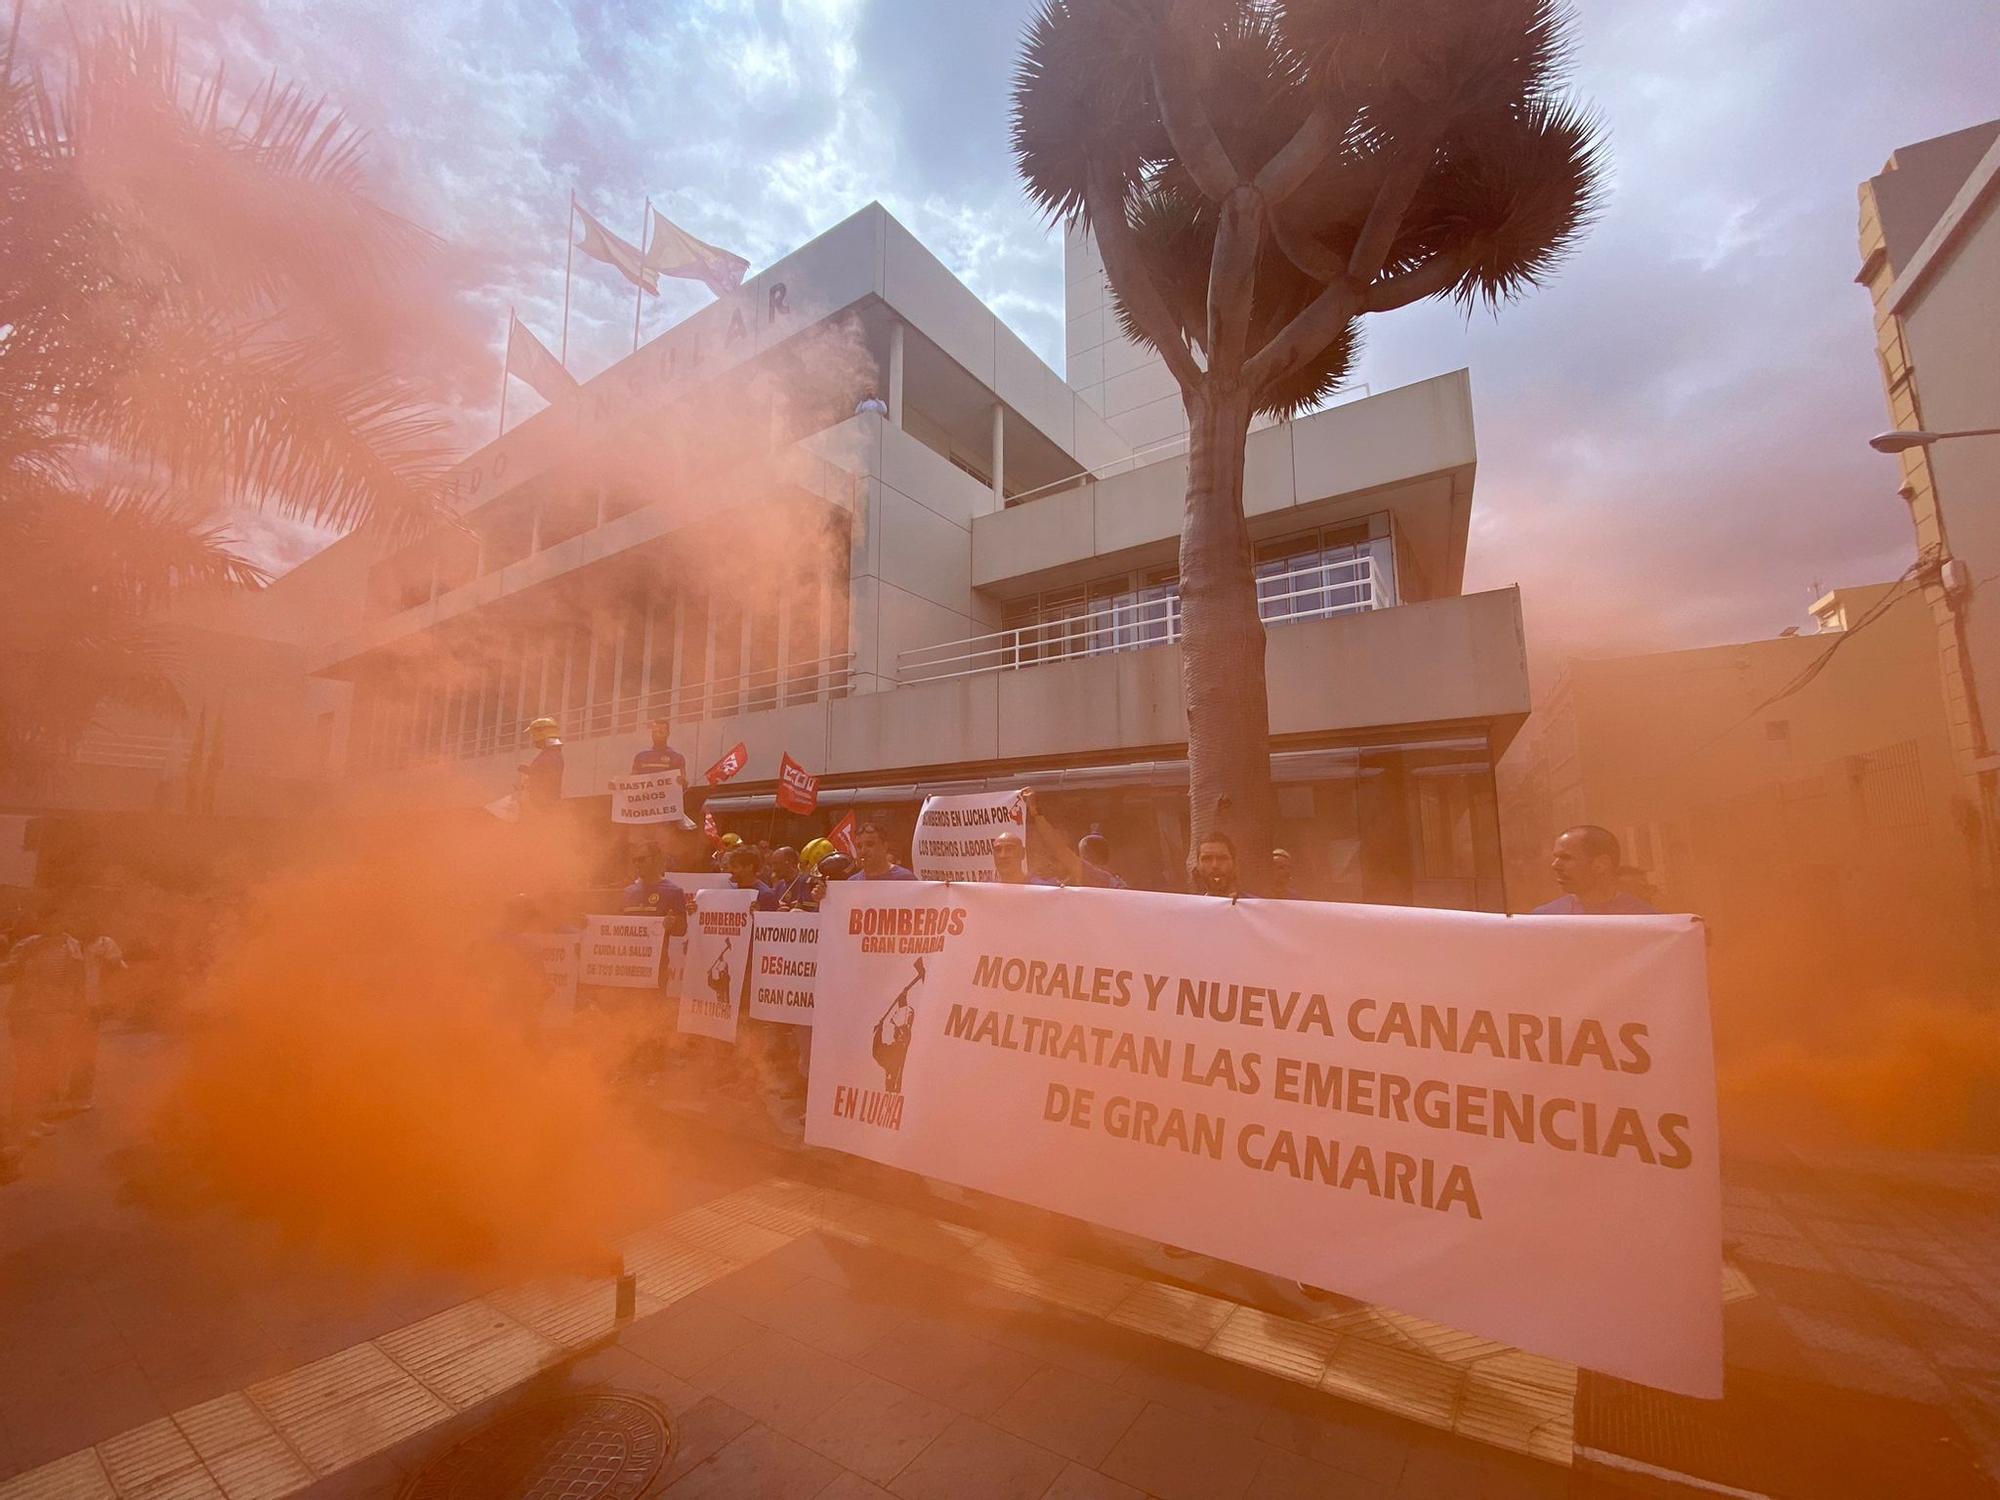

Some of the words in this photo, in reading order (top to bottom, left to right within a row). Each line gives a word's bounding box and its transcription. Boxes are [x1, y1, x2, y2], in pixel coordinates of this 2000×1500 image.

[619, 780, 655, 790] BASTA
[657, 778, 672, 787] DE
[627, 791, 666, 802] DAÑOS
[621, 805, 677, 818] MORALES
[951, 809, 961, 827] EN
[962, 808, 990, 826] LUCHA
[991, 807, 1011, 824] POR
[919, 839, 929, 855] LOS
[699, 914, 748, 927] BOMBEROS
[848, 907, 966, 936] BOMBEROS
[600, 924, 612, 938] SR.
[613, 925, 650, 939] MORALES,
[755, 927, 796, 945] ANTONIO
[593, 944, 616, 957] CUIDA
[617, 945, 627, 957] LA
[629, 945, 652, 958] SALUD
[861, 934, 896, 953] GRAN
[899, 935, 945, 953] CANARIA
[758, 987, 783, 1004] GRAN
[692, 999, 703, 1015] EN
[705, 1000, 731, 1019] LUCHA
[973, 954, 1131, 1007] MORALES
[1144, 974, 1170, 1012] Y
[1176, 978, 1334, 1037] NUEVA
[1347, 998, 1650, 1074] CANARIAS
[944, 1004, 1172, 1078] MALTRATAN
[1182, 1042, 1261, 1094] LAS
[1274, 1059, 1693, 1170] EMERGENCIAS
[833, 1085, 857, 1118] EN
[859, 1086, 904, 1131] LUCHA
[1044, 1082, 1096, 1128] DE
[1103, 1096, 1225, 1157] GRAN
[1237, 1123, 1483, 1220] CANARIA
